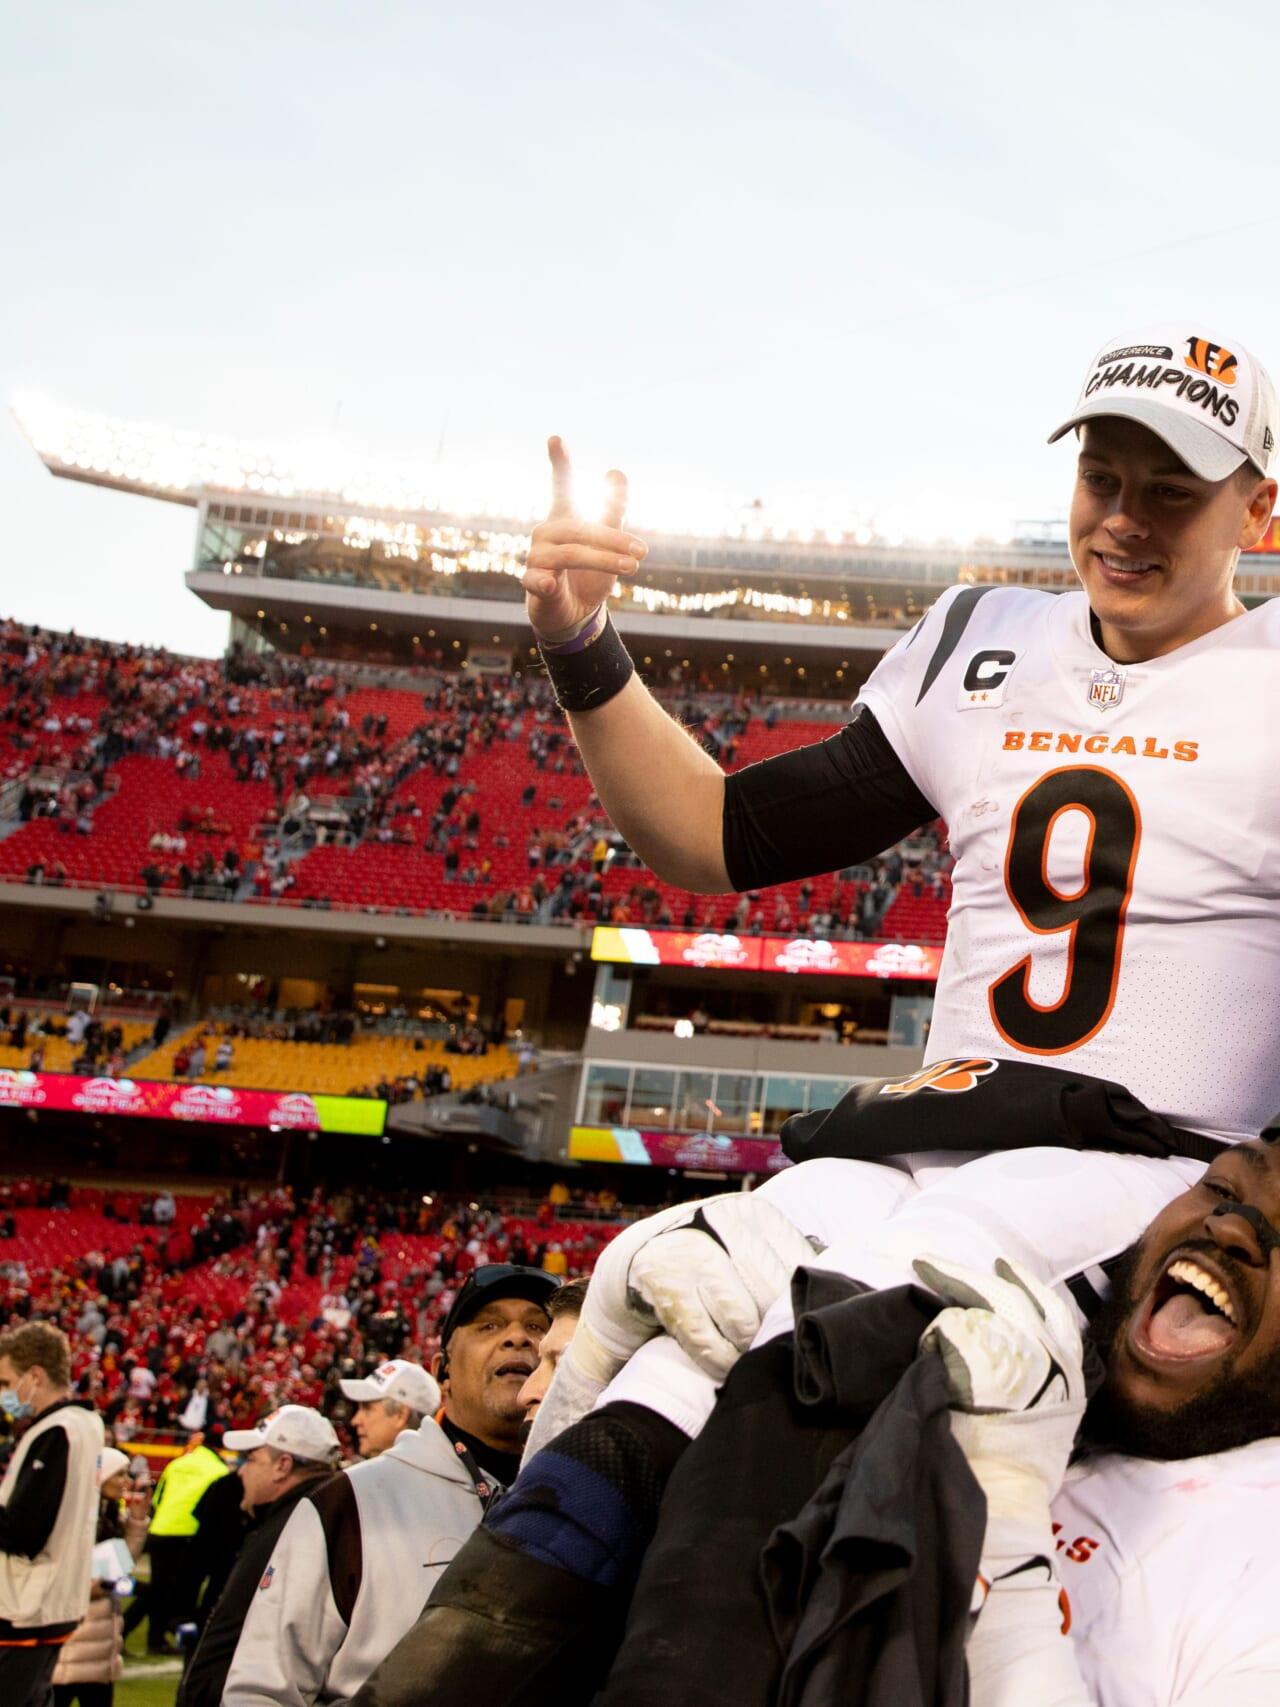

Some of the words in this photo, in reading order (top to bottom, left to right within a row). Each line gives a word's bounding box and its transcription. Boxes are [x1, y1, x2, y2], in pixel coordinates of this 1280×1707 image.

[1085, 362, 1239, 427] CHAMPIONS
[963, 650, 1016, 691] C
[1092, 684, 1117, 702] NFL
[1002, 731, 1199, 762] BENGALS
[988, 764, 1142, 1056] 9
